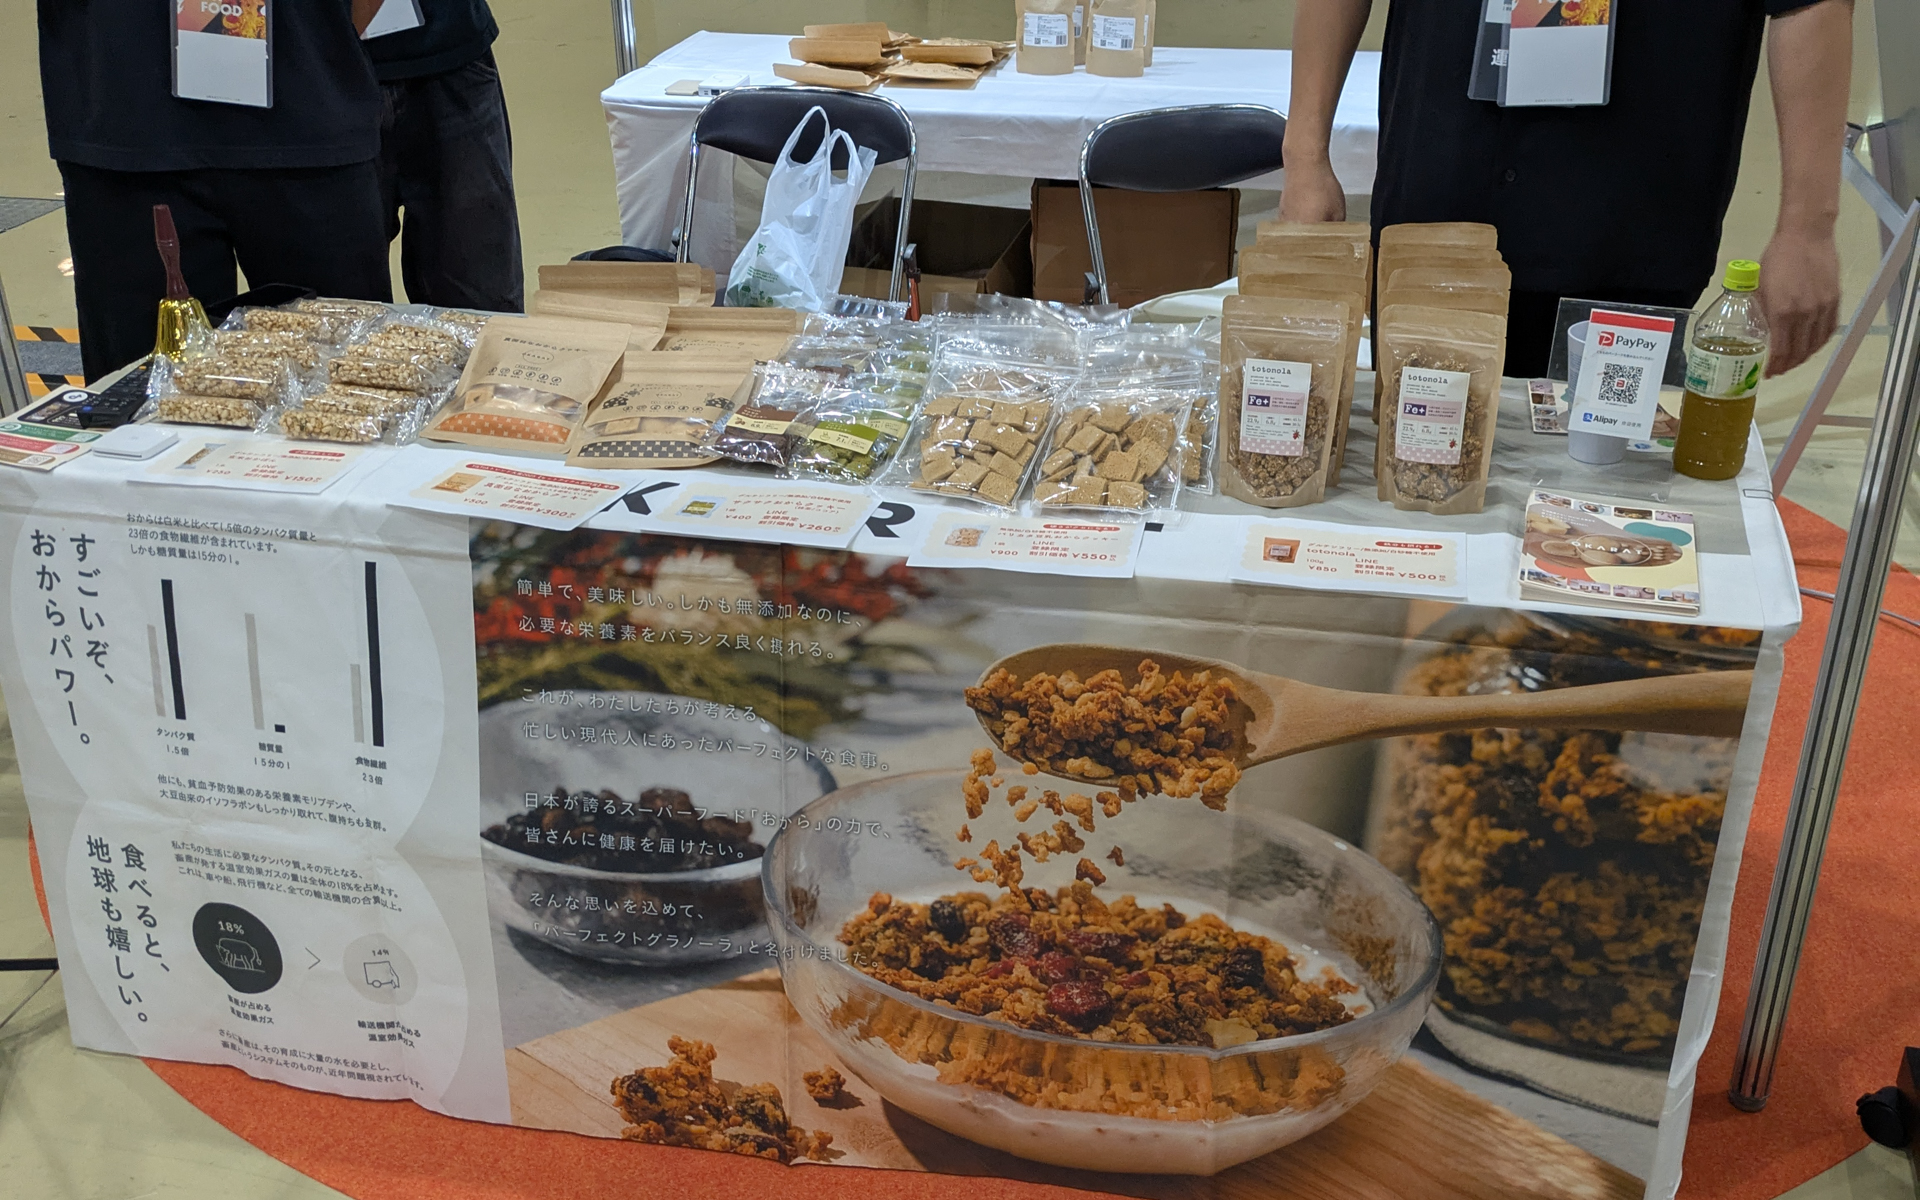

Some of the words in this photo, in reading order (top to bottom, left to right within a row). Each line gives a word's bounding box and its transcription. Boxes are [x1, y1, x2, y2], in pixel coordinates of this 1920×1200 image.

[200, 2, 243, 17] FOOD
[1616, 335, 1657, 352] PayPay
[1251, 365, 1292, 375] totonola
[1408, 374, 1448, 384] totonola
[1249, 395, 1269, 406] Fe+
[1404, 403, 1425, 414] Fe+
[1593, 415, 1618, 426] Alipay
[463, 497, 489, 506] ¥500
[536, 506, 571, 518] ¥300
[799, 522, 832, 532] ¥260
[128, 528, 278, 554] 23倍の食物繊維が含まれています。
[1571, 540, 1644, 555] OKARAT
[1072, 552, 1108, 560] ¥550
[1306, 548, 1356, 557] totonola
[1355, 557, 1379, 565] LINE
[1308, 565, 1338, 573] ¥850
[1354, 569, 1395, 577] 割引価格
[1398, 571, 1437, 580] ¥500
[70, 533, 115, 684] すごいぞ、
[516, 578, 864, 628] 簡単で、美味しい。しかも無添加なのに、
[30, 529, 92, 746] おからパワー。
[518, 614, 835, 660] 必要な栄養素をバランス良く摂れる。
[522, 687, 768, 725] これが、わたしたちが考える、
[156, 726, 196, 741] タンパク質
[258, 741, 284, 755] 糖質量
[522, 721, 890, 772] 忙しい現代人にあったパーフェクトな食事。
[356, 755, 388, 771] 食物繊維
[361, 771, 384, 786] 23倍
[524, 792, 892, 839] 日本が誇るスーパーフード「おから」の力で、
[525, 826, 744, 860] 皆さんに健康を届けたい。
[121, 842, 171, 972] 食べると、
[529, 892, 704, 920] そんな思いを込めて、
[87, 834, 148, 1023] 地球も嬉しい。
[218, 920, 245, 936] 18%
[372, 949, 390, 957] 14%
[533, 921, 880, 971] 「パーフェクトグラノーラ」と名付けました。
